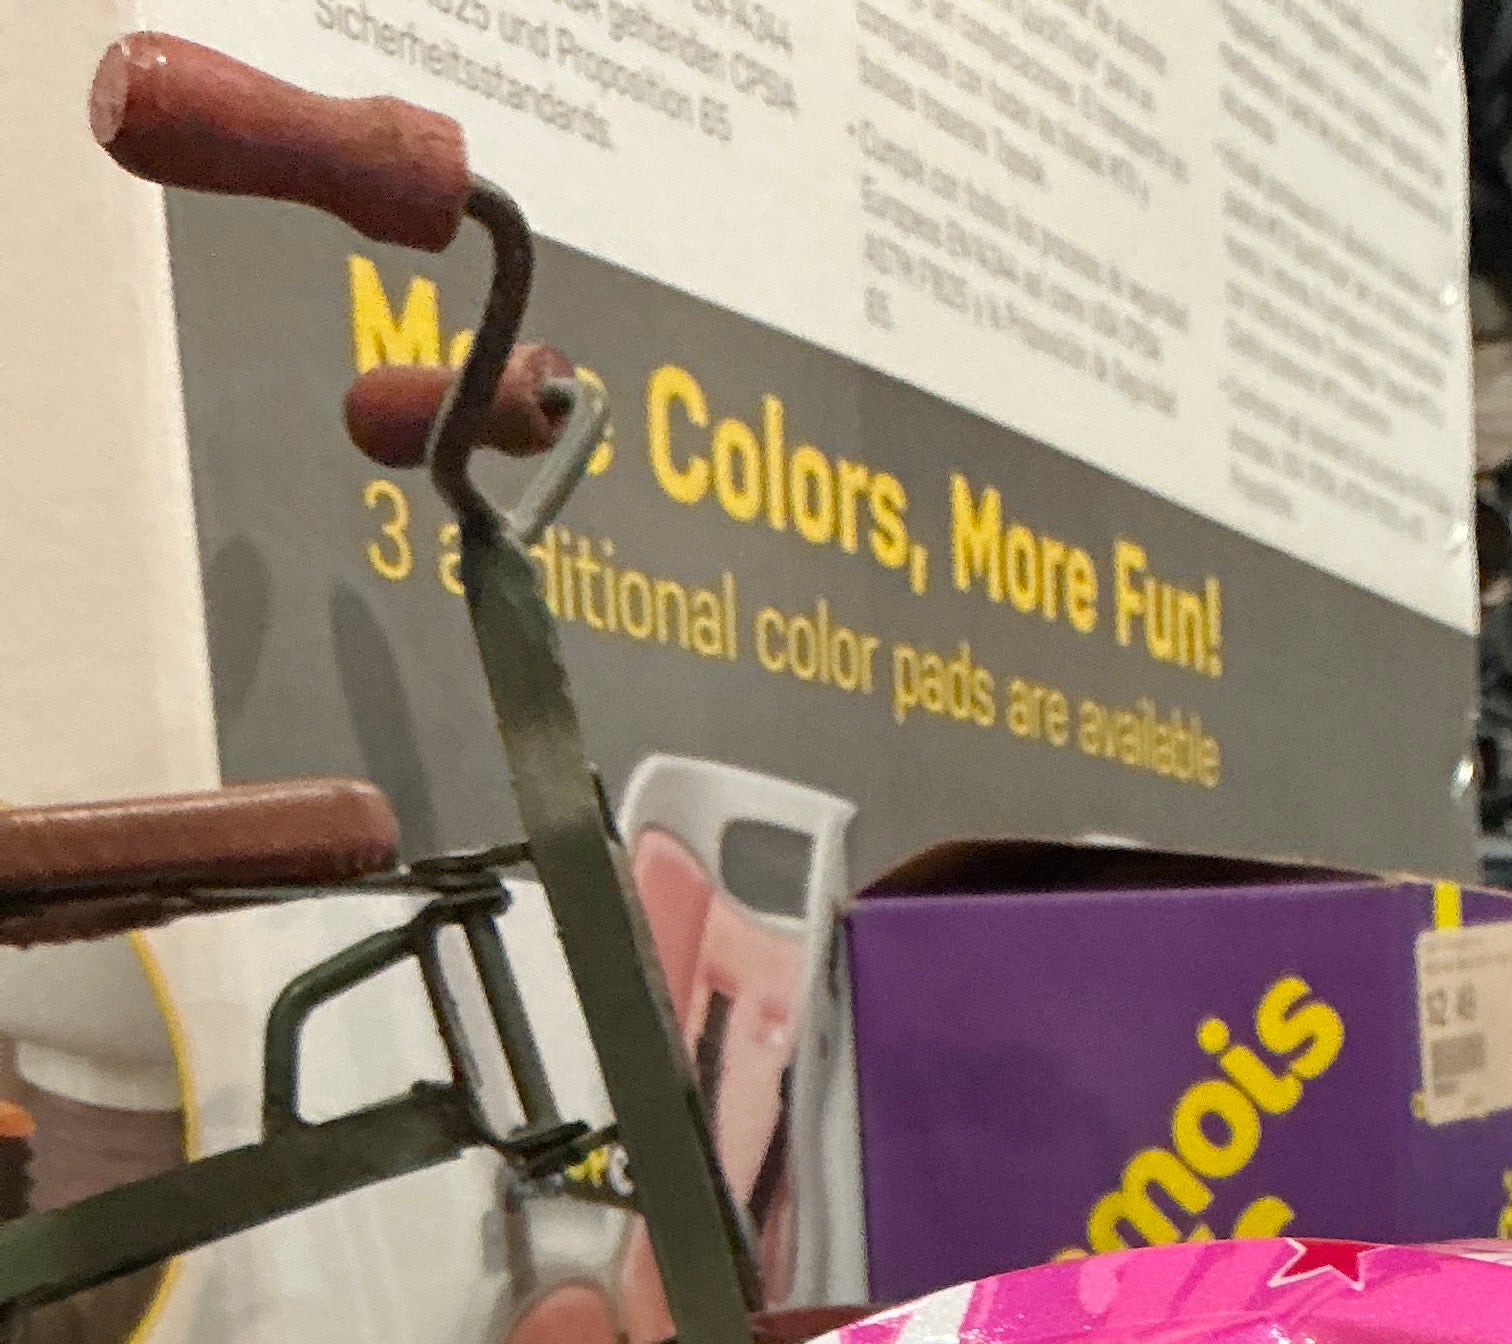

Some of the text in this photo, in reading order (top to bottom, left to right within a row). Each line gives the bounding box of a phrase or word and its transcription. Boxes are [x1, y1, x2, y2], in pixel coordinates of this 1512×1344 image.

[347, 252, 614, 478] Me
[645, 362, 929, 597] Colors,
[952, 470, 1099, 636] More
[1113, 534, 1223, 679] Fun!
[362, 477, 1222, 790] 3 aditional color pads are available
[1050, 971, 1347, 1262] mois
